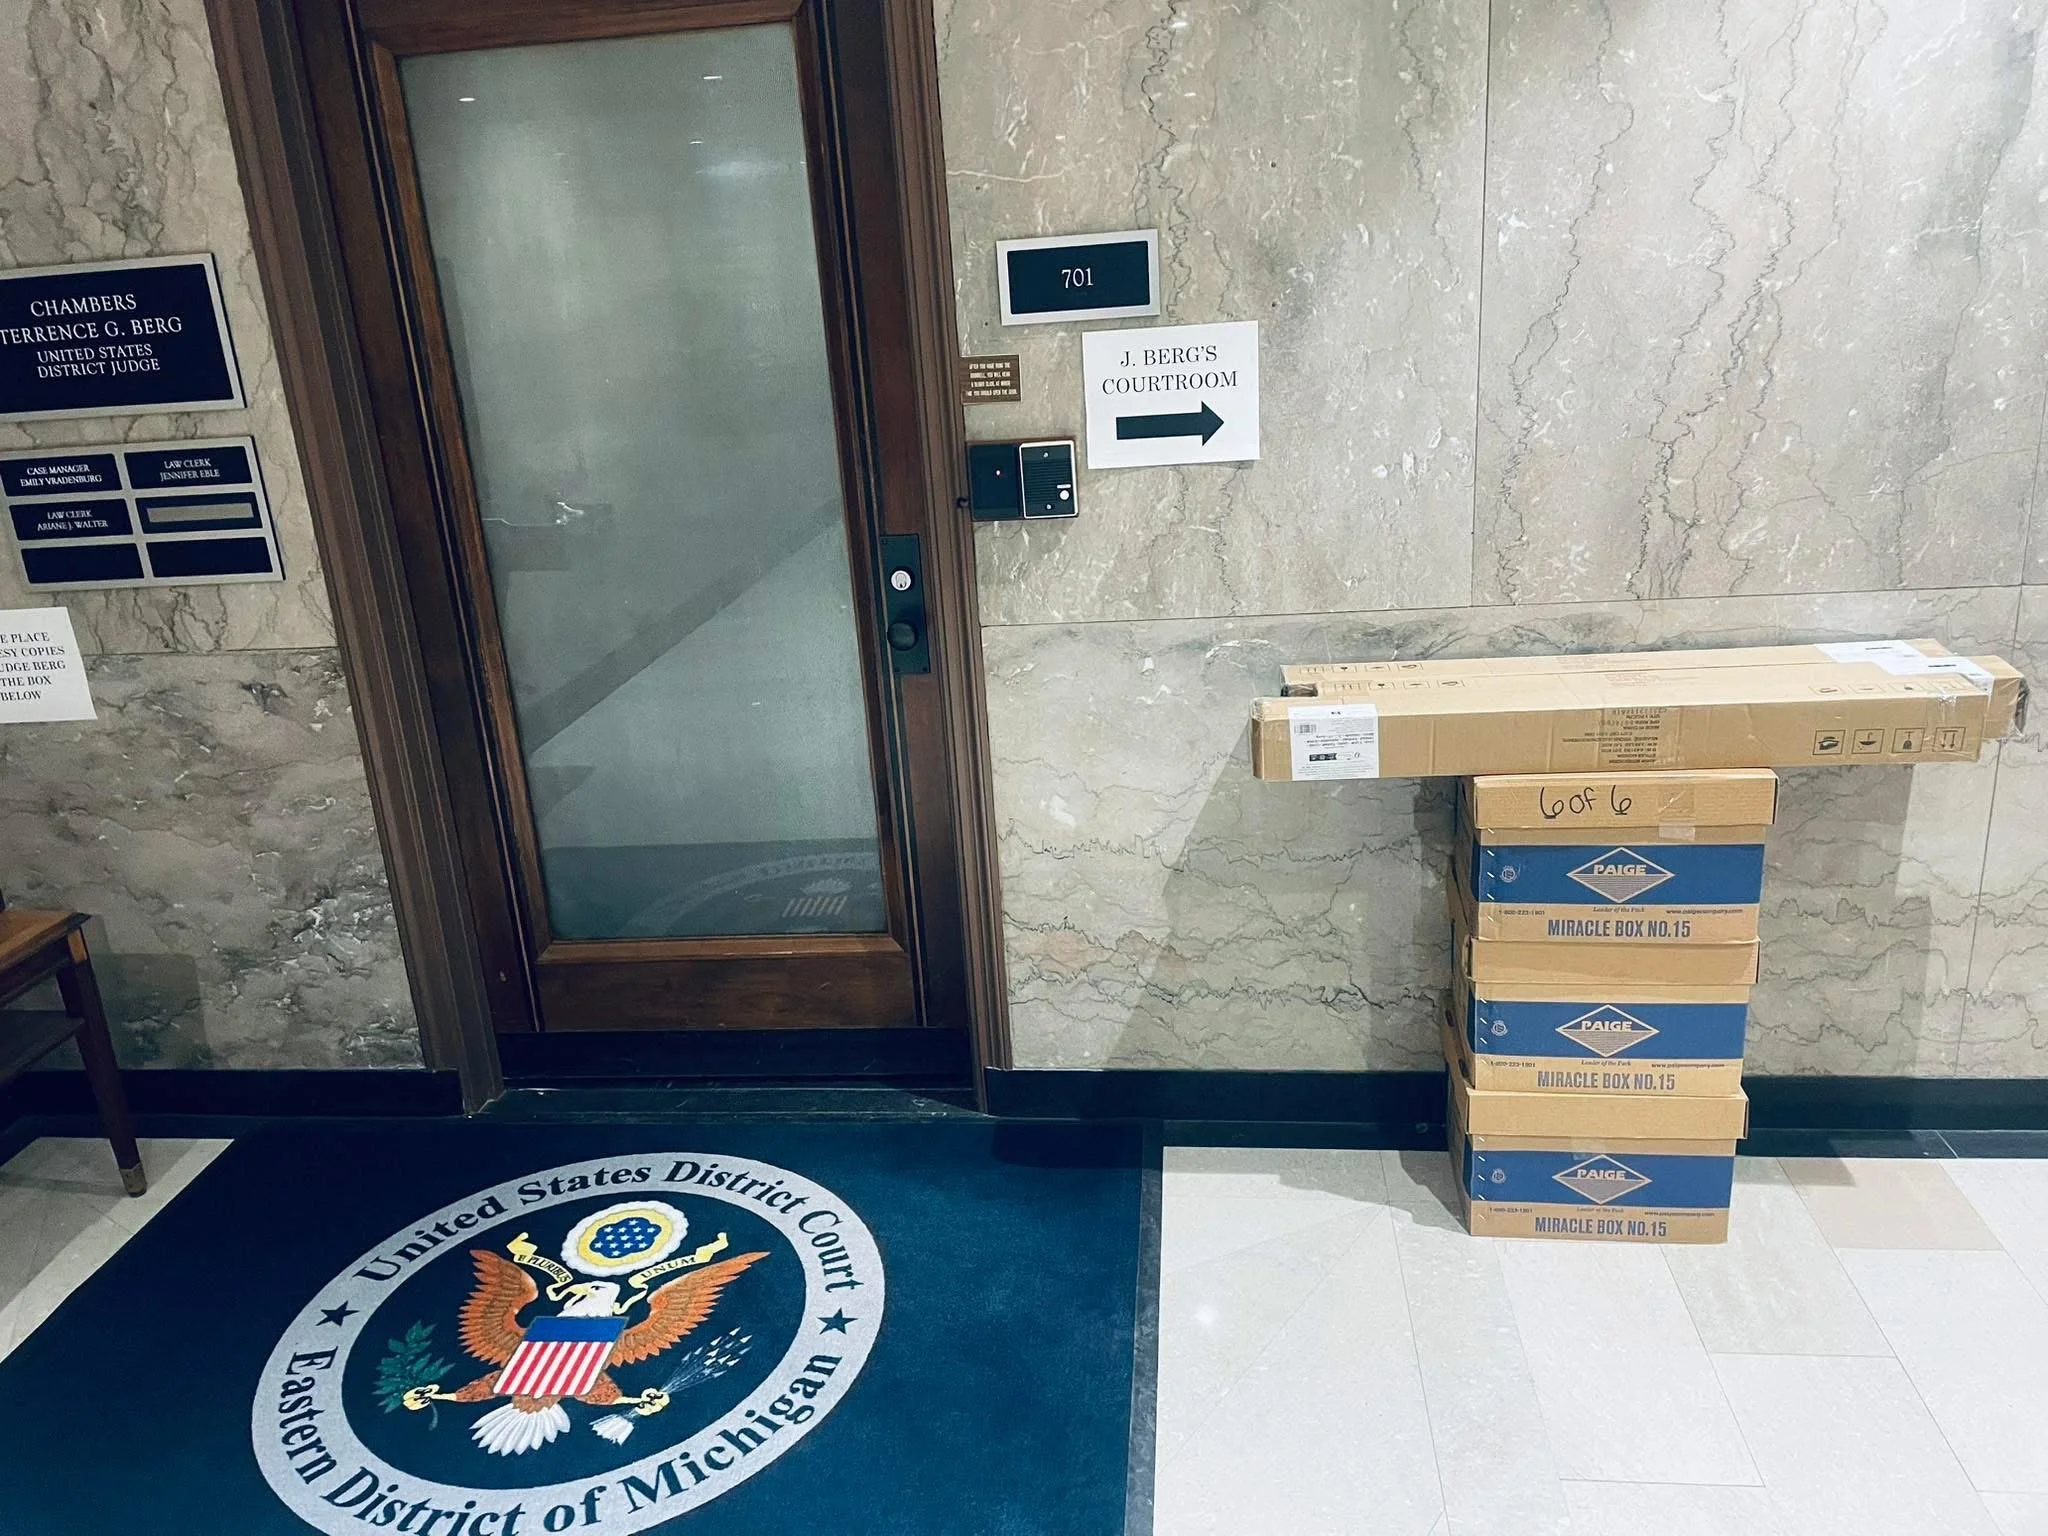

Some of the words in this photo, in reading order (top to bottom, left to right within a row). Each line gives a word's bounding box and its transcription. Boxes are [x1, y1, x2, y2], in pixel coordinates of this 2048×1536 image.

[1061, 267, 1094, 289] 701
[31, 294, 136, 317] CHAMBERS
[0, 323, 99, 345] TERRENCE
[104, 321, 125, 337] G.
[130, 316, 182, 335] BERG
[37, 347, 95, 363] UNITED
[99, 343, 153, 359] STATES
[1120, 350, 1136, 368] J.
[1144, 345, 1218, 367] BERG'S
[37, 361, 105, 378] DISTRICT
[111, 358, 160, 376] JUDGE
[1102, 371, 1238, 395] COURTROOM
[27, 466, 48, 476] CASE
[49, 464, 90, 474] MANAGER
[164, 460, 182, 469] LAW
[183, 458, 212, 468] CLERK
[20, 477, 45, 487] EMILY
[45, 475, 102, 486] VRADENBURG
[160, 470, 199, 482] JENNIFER
[200, 469, 220, 478] EBLE
[47, 511, 65, 519] LAW
[66, 510, 92, 519] CLERK
[37, 521, 68, 531] ARIANE
[74, 520, 108, 528] WALTER
[11, 632, 50, 643] PLACE
[21, 646, 65, 656] COPIES
[32, 660, 66, 670] BERG
[0, 677, 24, 687] THE
[27, 675, 52, 686] BOX
[0, 690, 41, 701] BELOW
[1540, 786, 1564, 819] 6
[1611, 785, 1632, 815] 6
[1593, 864, 1646, 875] PAIGE
[1548, 919, 1610, 937] MIRACLE
[1615, 920, 1643, 937] BOX
[1581, 1020, 1632, 1032] PAIGE
[1538, 1071, 1598, 1088] MIRACLE
[1603, 1073, 1630, 1089] BOX
[1577, 1169, 1626, 1180] PAIGE
[352, 1196, 508, 1281] United
[517, 1166, 652, 1206] States
[664, 1160, 810, 1214] District
[798, 1210, 864, 1293] Court
[1535, 1217, 1593, 1234] MIRACLE
[1598, 1219, 1624, 1236] BOX
[518, 1254, 526, 1262] E
[528, 1256, 572, 1283] PLURIBUS
[641, 1256, 696, 1279] UNUM
[278, 1346, 338, 1484] Eastern
[320, 1466, 525, 1536] District
[543, 1485, 607, 1533] of
[617, 1354, 842, 1514] Michigan
